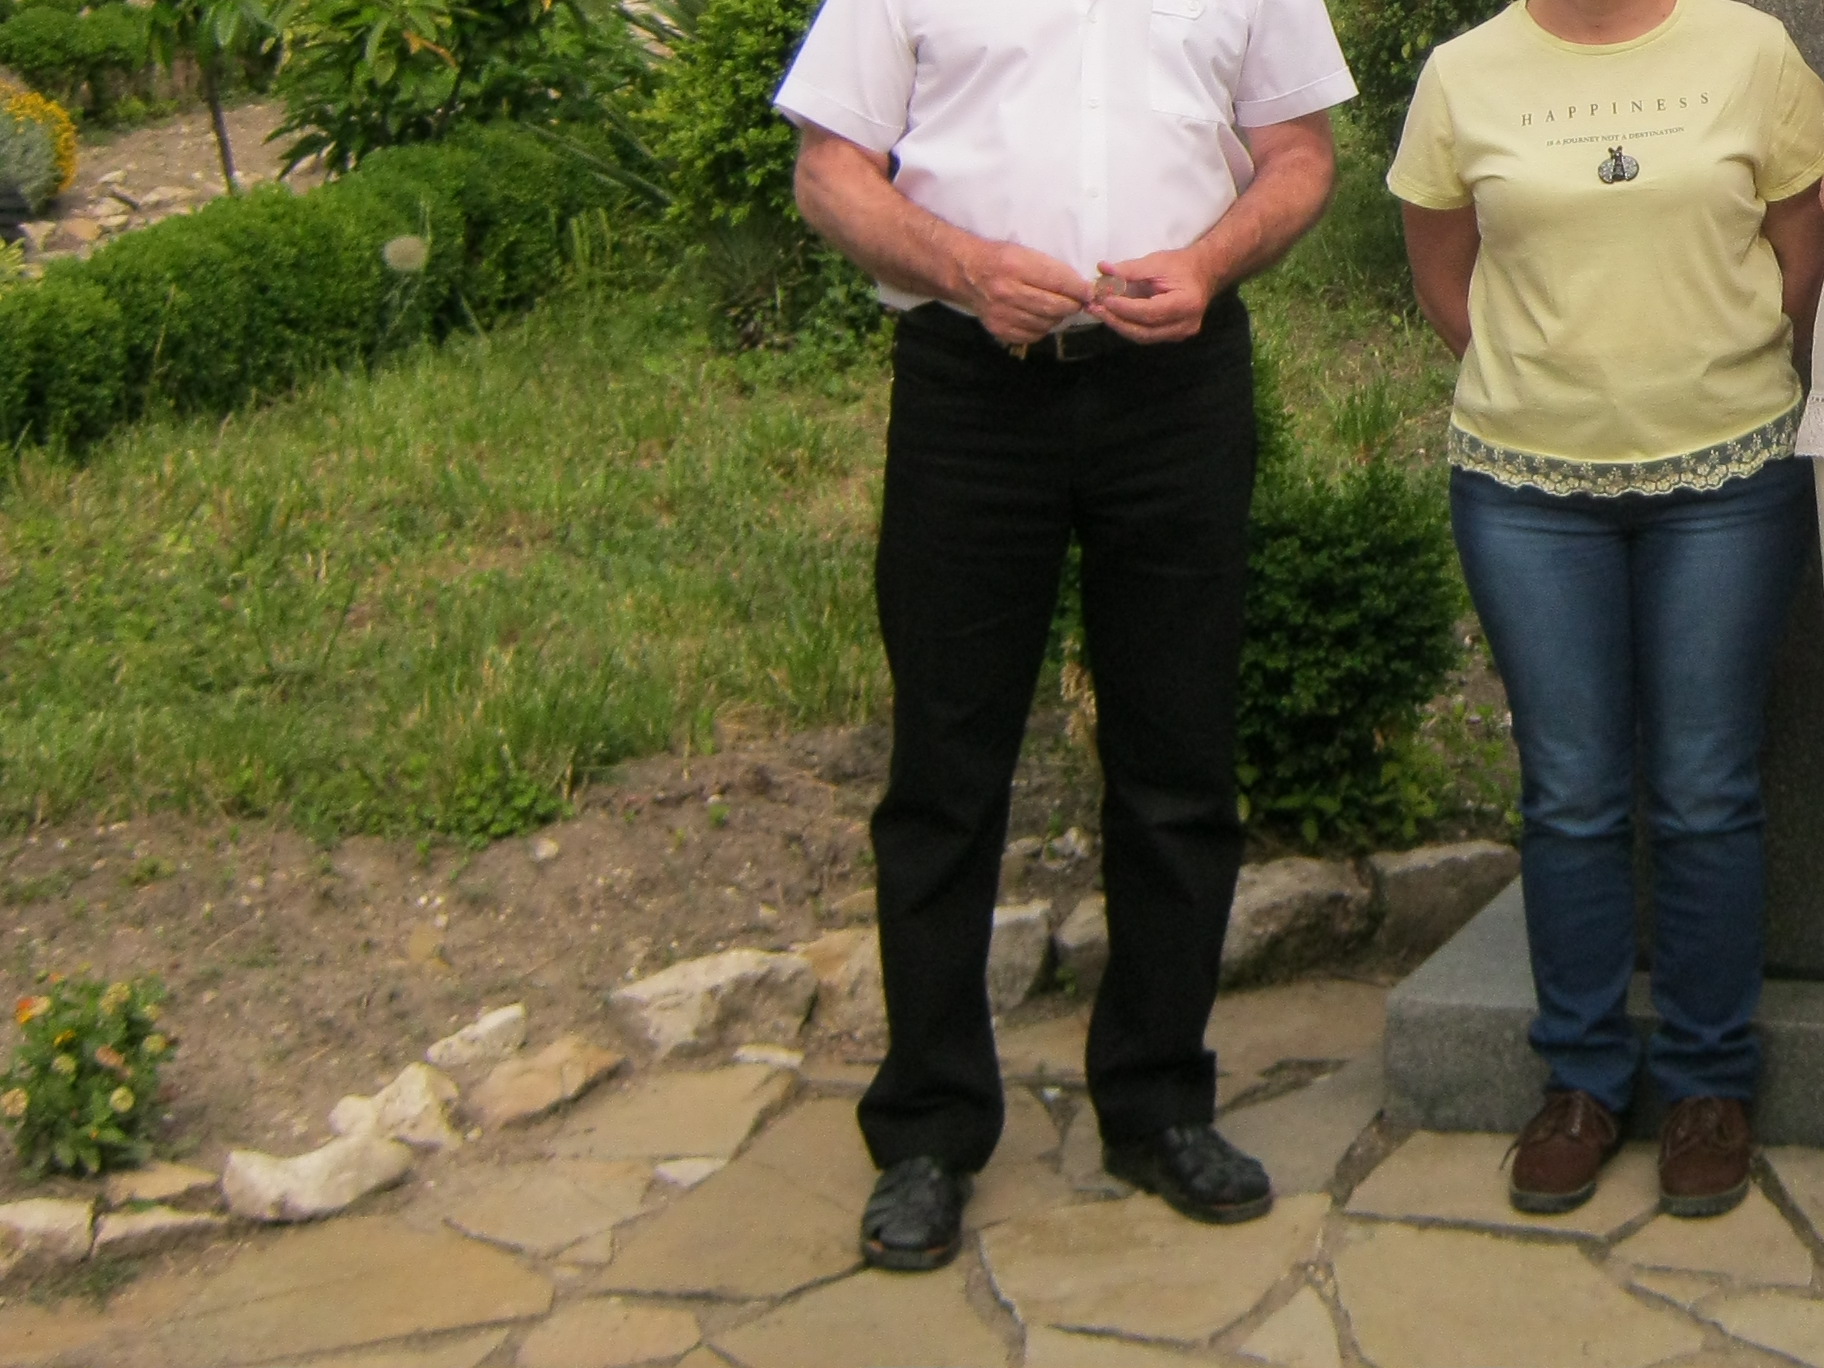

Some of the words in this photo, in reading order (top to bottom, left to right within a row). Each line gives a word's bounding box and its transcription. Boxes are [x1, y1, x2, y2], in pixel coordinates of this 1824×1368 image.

[1521, 92, 1709, 126] HAPPINESS
[1555, 138, 1562, 146] A
[1562, 135, 1600, 146] JOURNEY
[1601, 134, 1620, 142] NOT
[1621, 133, 1628, 141] A
[1628, 126, 1685, 139] DESTINATION
